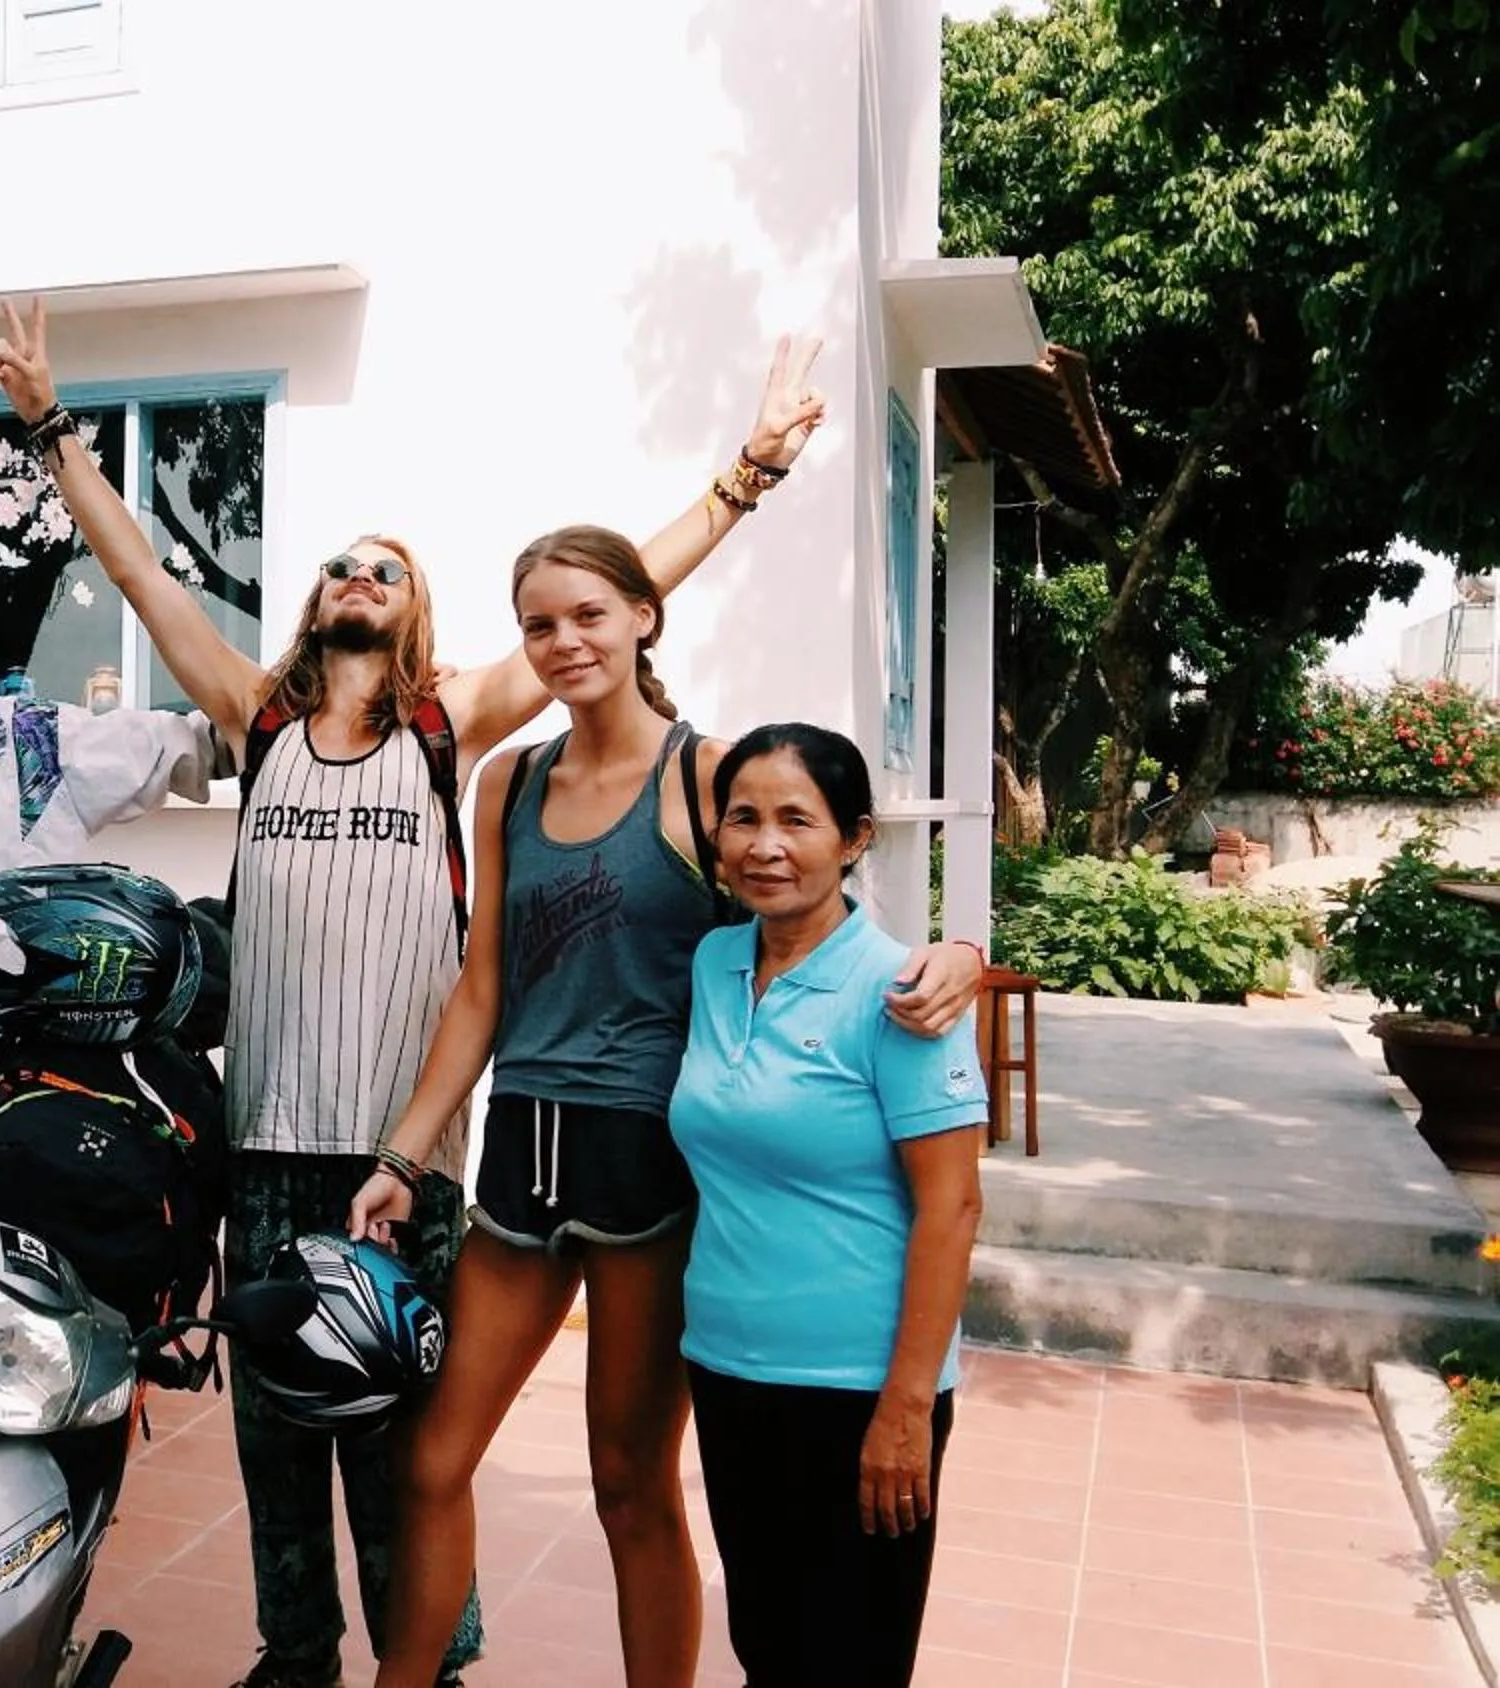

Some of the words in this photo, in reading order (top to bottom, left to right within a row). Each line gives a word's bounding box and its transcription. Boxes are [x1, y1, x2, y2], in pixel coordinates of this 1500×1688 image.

[251, 805, 340, 843] HOME
[347, 806, 421, 847] RUN
[59, 1008, 136, 1022] MONSTER
